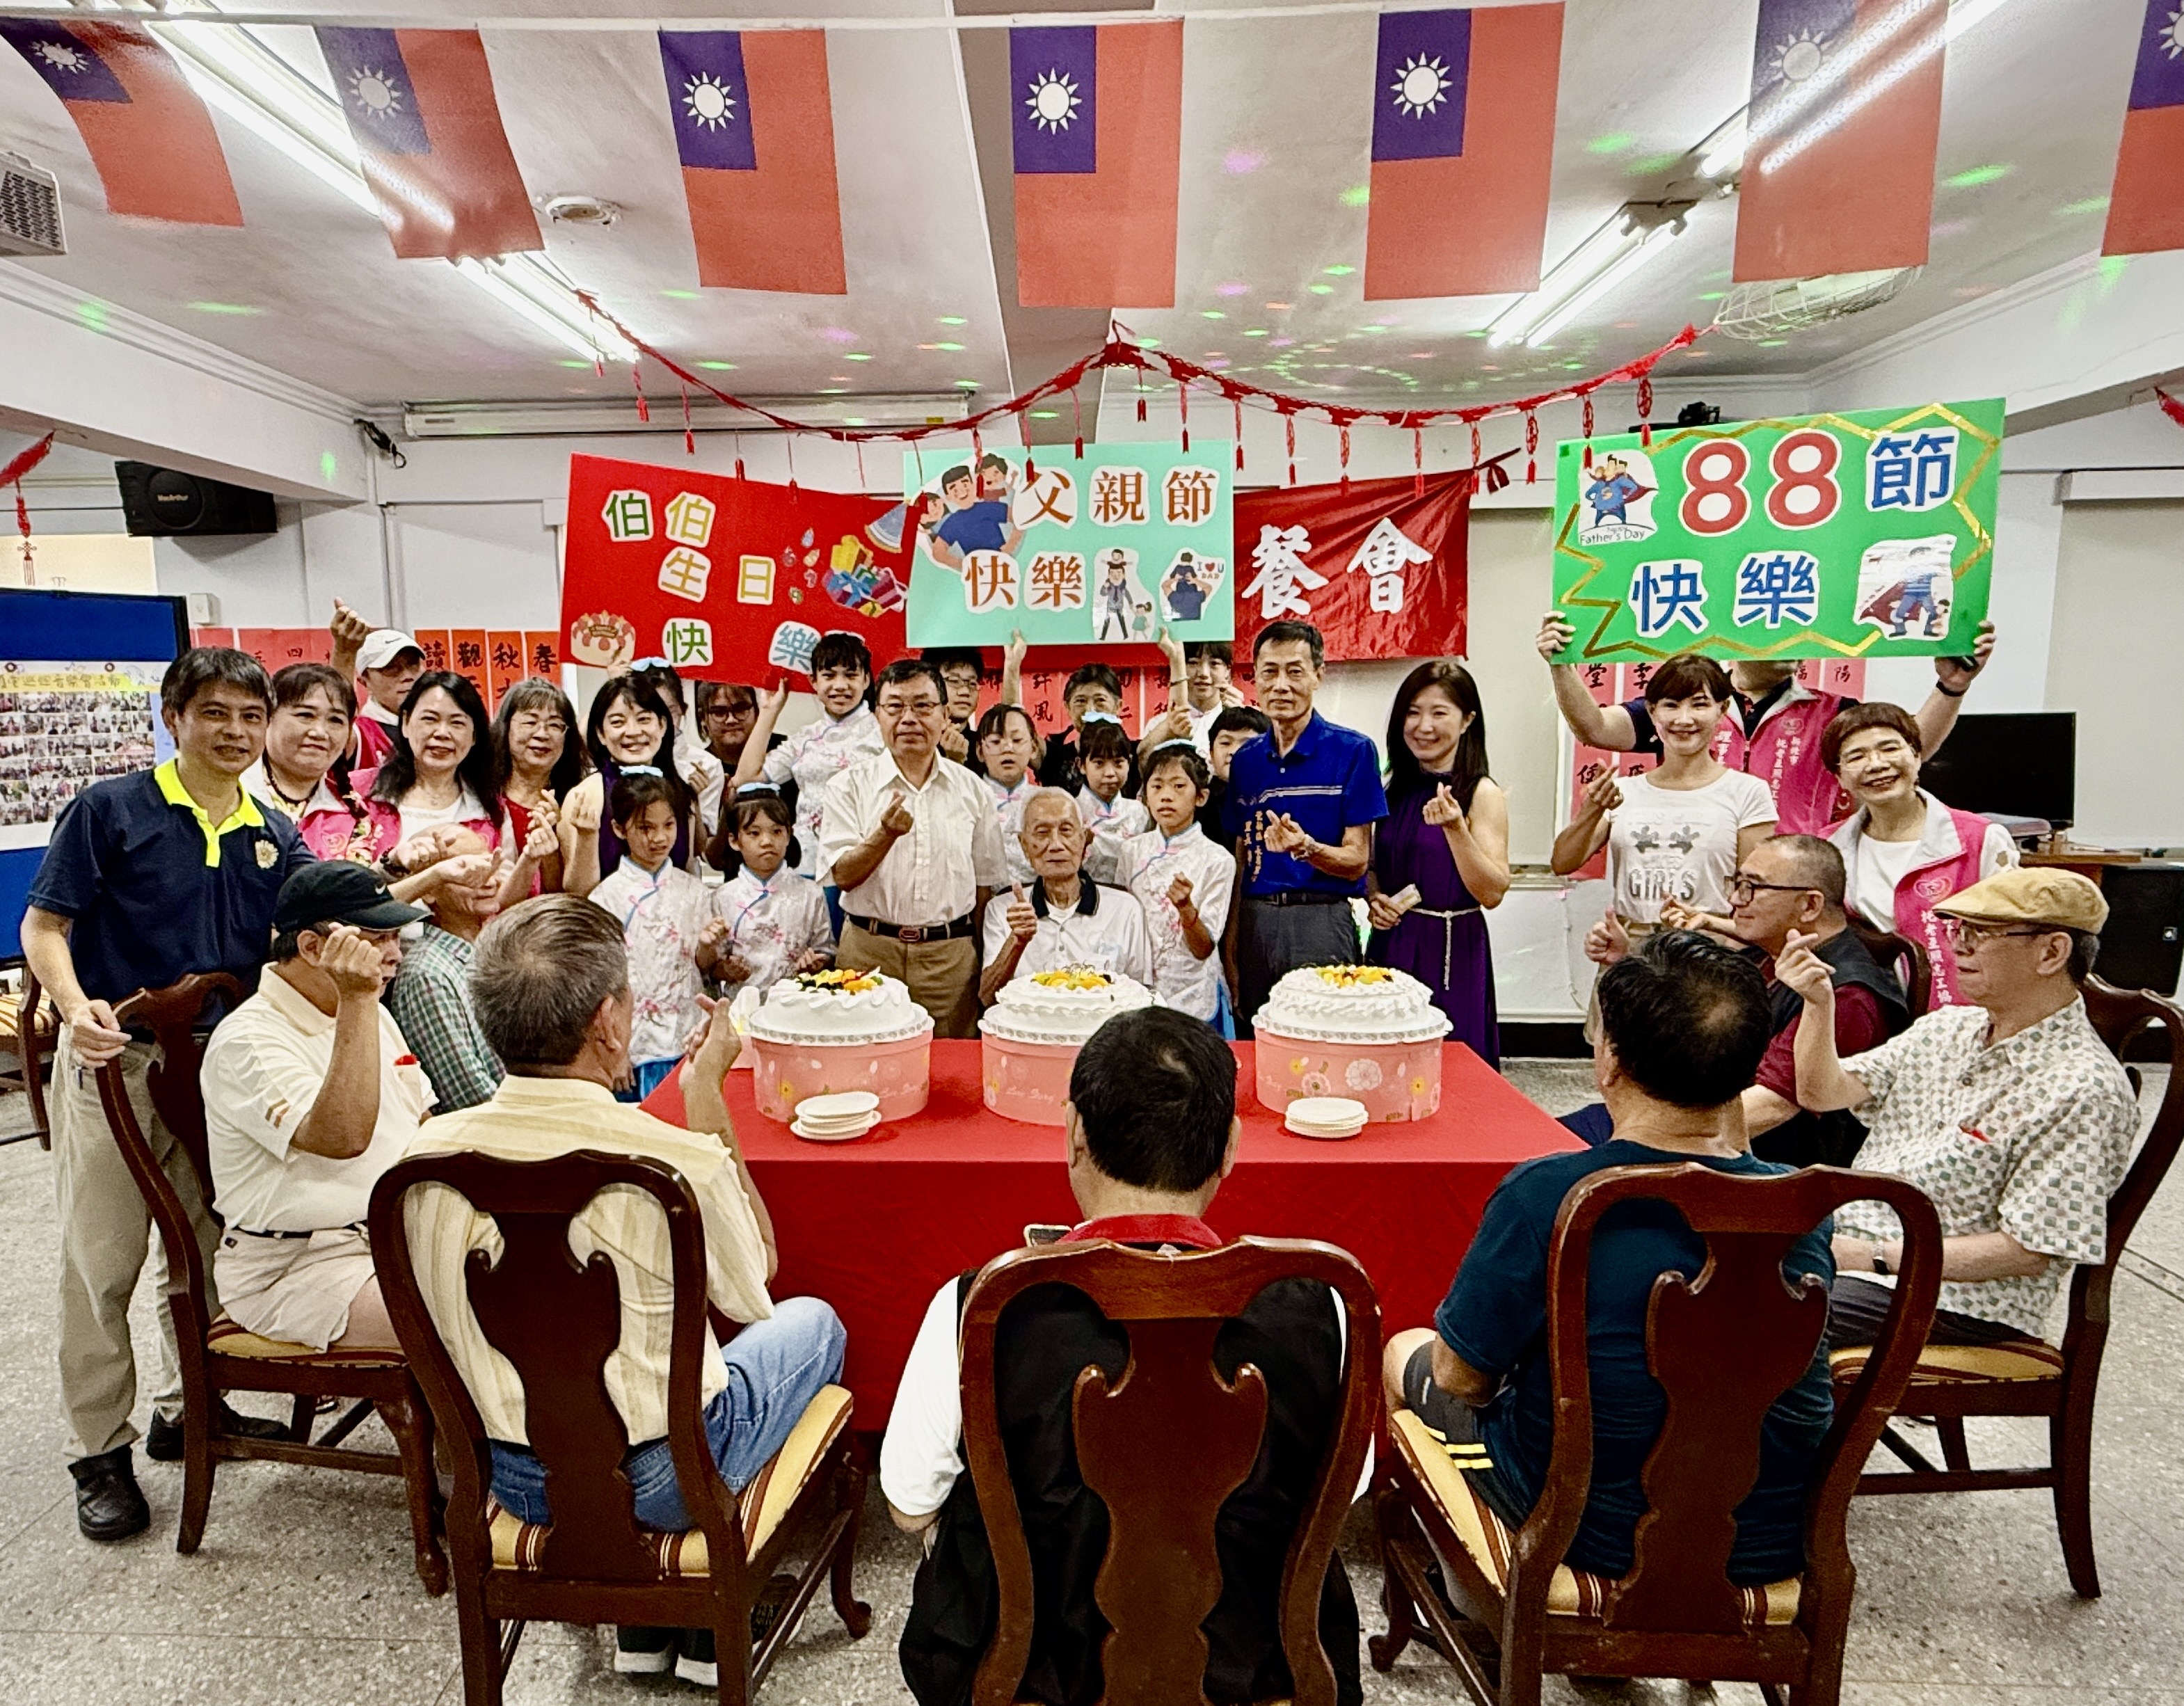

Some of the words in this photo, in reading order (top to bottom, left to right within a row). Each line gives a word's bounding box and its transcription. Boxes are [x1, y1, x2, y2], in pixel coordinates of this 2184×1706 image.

[606, 493, 710, 543] 伯伯
[1021, 470, 1218, 526] 父親節
[1580, 532, 1621, 544] Father's
[1624, 529, 1645, 539] Day
[662, 552, 772, 603] 生日
[966, 556, 1082, 607] 快樂
[1242, 518, 1433, 619] 餐會
[1632, 556, 1815, 632] 快樂
[534, 643, 558, 673] 春
[666, 622, 817, 674] 快樂
[1629, 869, 1695, 901] GIRLS
